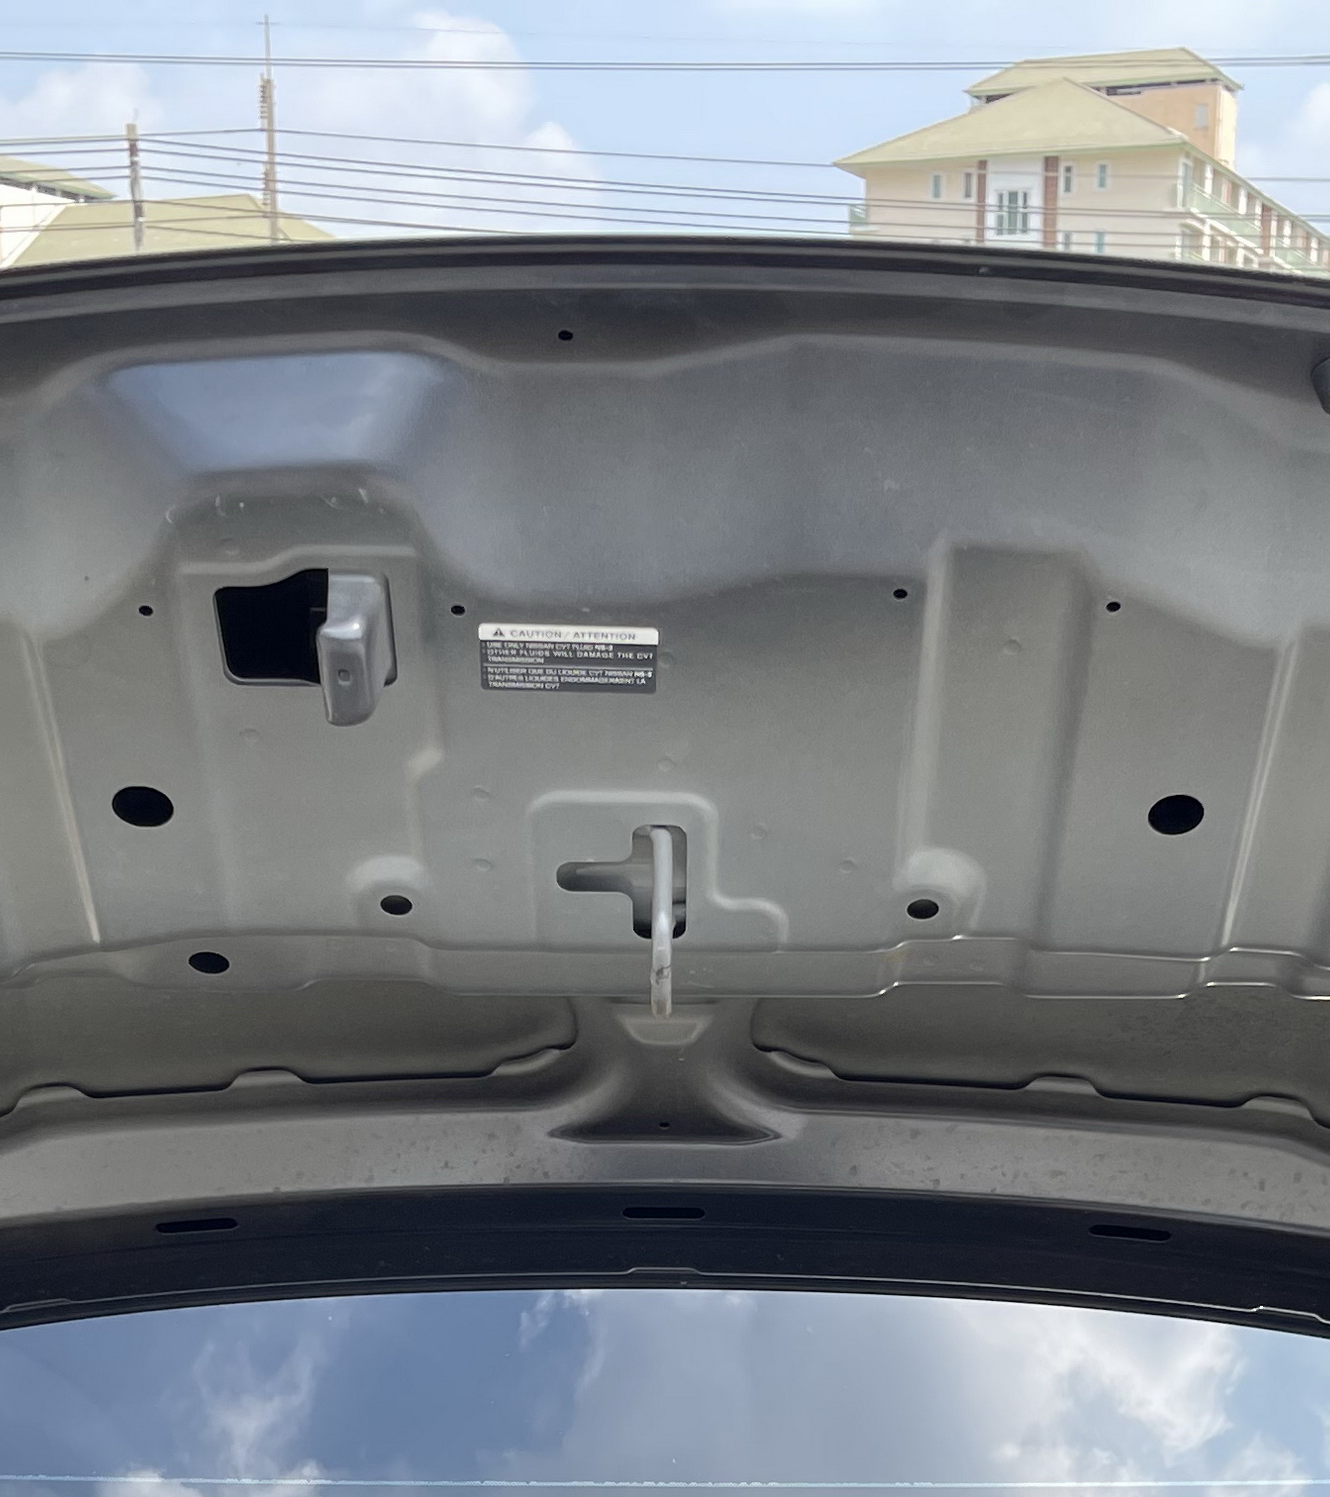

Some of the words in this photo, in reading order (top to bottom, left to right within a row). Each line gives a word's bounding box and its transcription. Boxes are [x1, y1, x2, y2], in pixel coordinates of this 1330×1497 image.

[510, 630, 561, 639] CAUTION
[573, 631, 636, 640] ATTENTION
[487, 648, 517, 656] OTHER
[617, 652, 634, 660] THE
